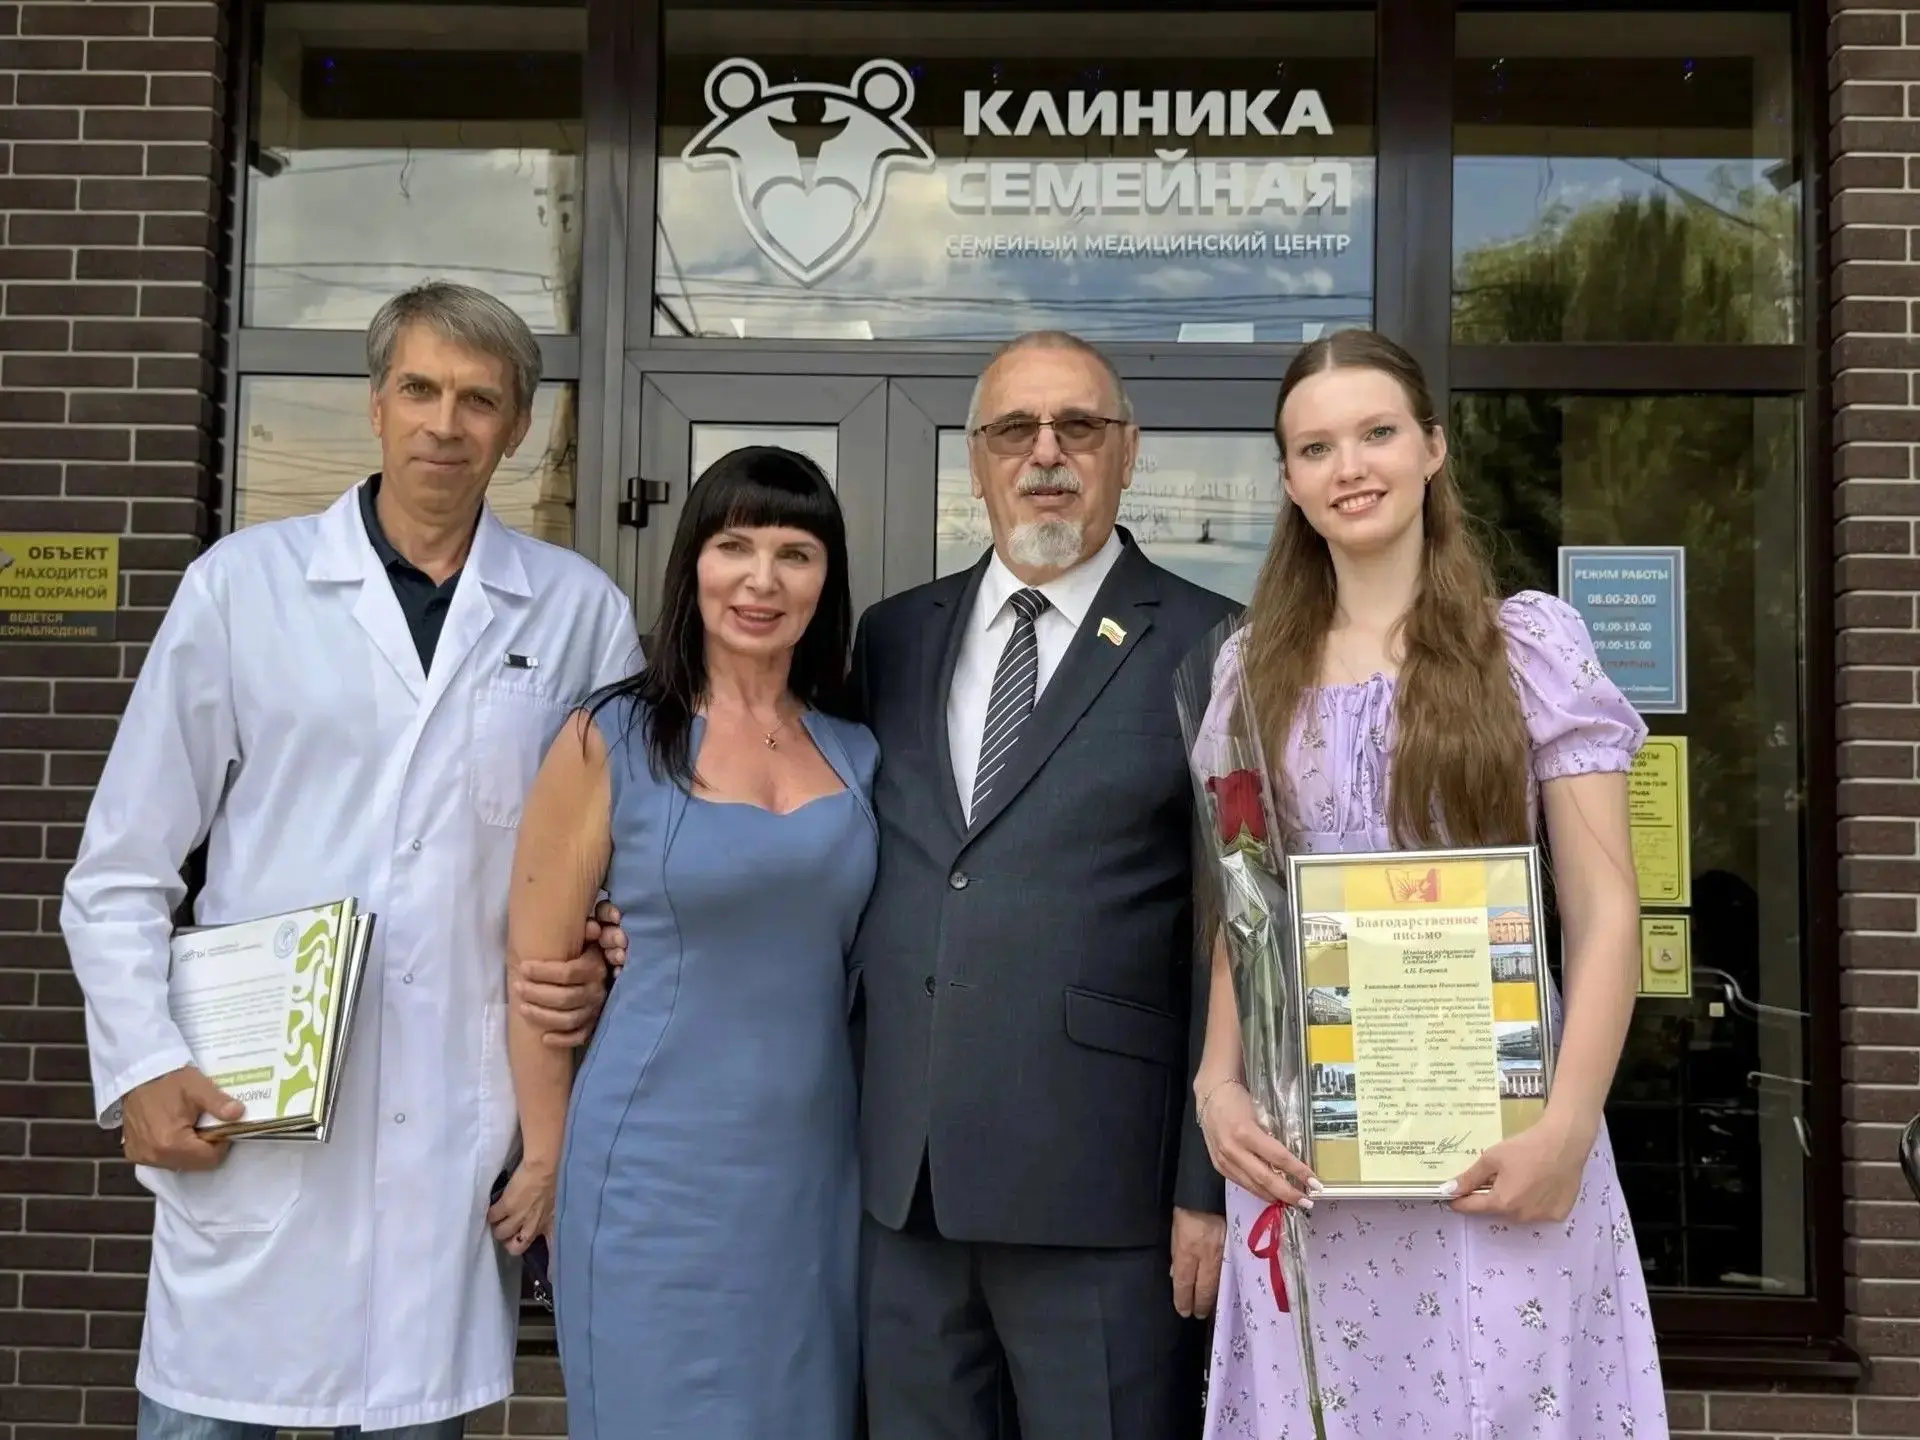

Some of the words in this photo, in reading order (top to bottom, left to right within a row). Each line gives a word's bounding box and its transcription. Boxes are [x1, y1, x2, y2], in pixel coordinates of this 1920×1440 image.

[963, 89, 1334, 137] КЛИНИКА
[946, 148, 1352, 210] СЕМЕЙНАЯ
[946, 231, 1077, 252] СЕМЕЙНЫЙ
[1085, 230, 1267, 254] МЕДИЦИНСКИЙ
[1274, 233, 1351, 254] ЦЕНТР
[28, 546, 110, 560] ОБЪЕКТ
[14, 567, 109, 581] НАХОДИТСЯ
[1574, 569, 1619, 580] РЕЖИМ
[1621, 569, 1669, 580] РАБОТЫ
[0, 585, 31, 600] ПОД
[34, 584, 108, 599] ОХРАНОЙ
[1587, 594, 1656, 605] 08.00-20.00
[0, 625, 98, 637] ЕОНАБЛЮДЕНИЕ
[1592, 622, 1652, 632] 09.00-19.00
[1356, 914, 1479, 930] Благодарственное
[1393, 931, 1443, 941] письмо
